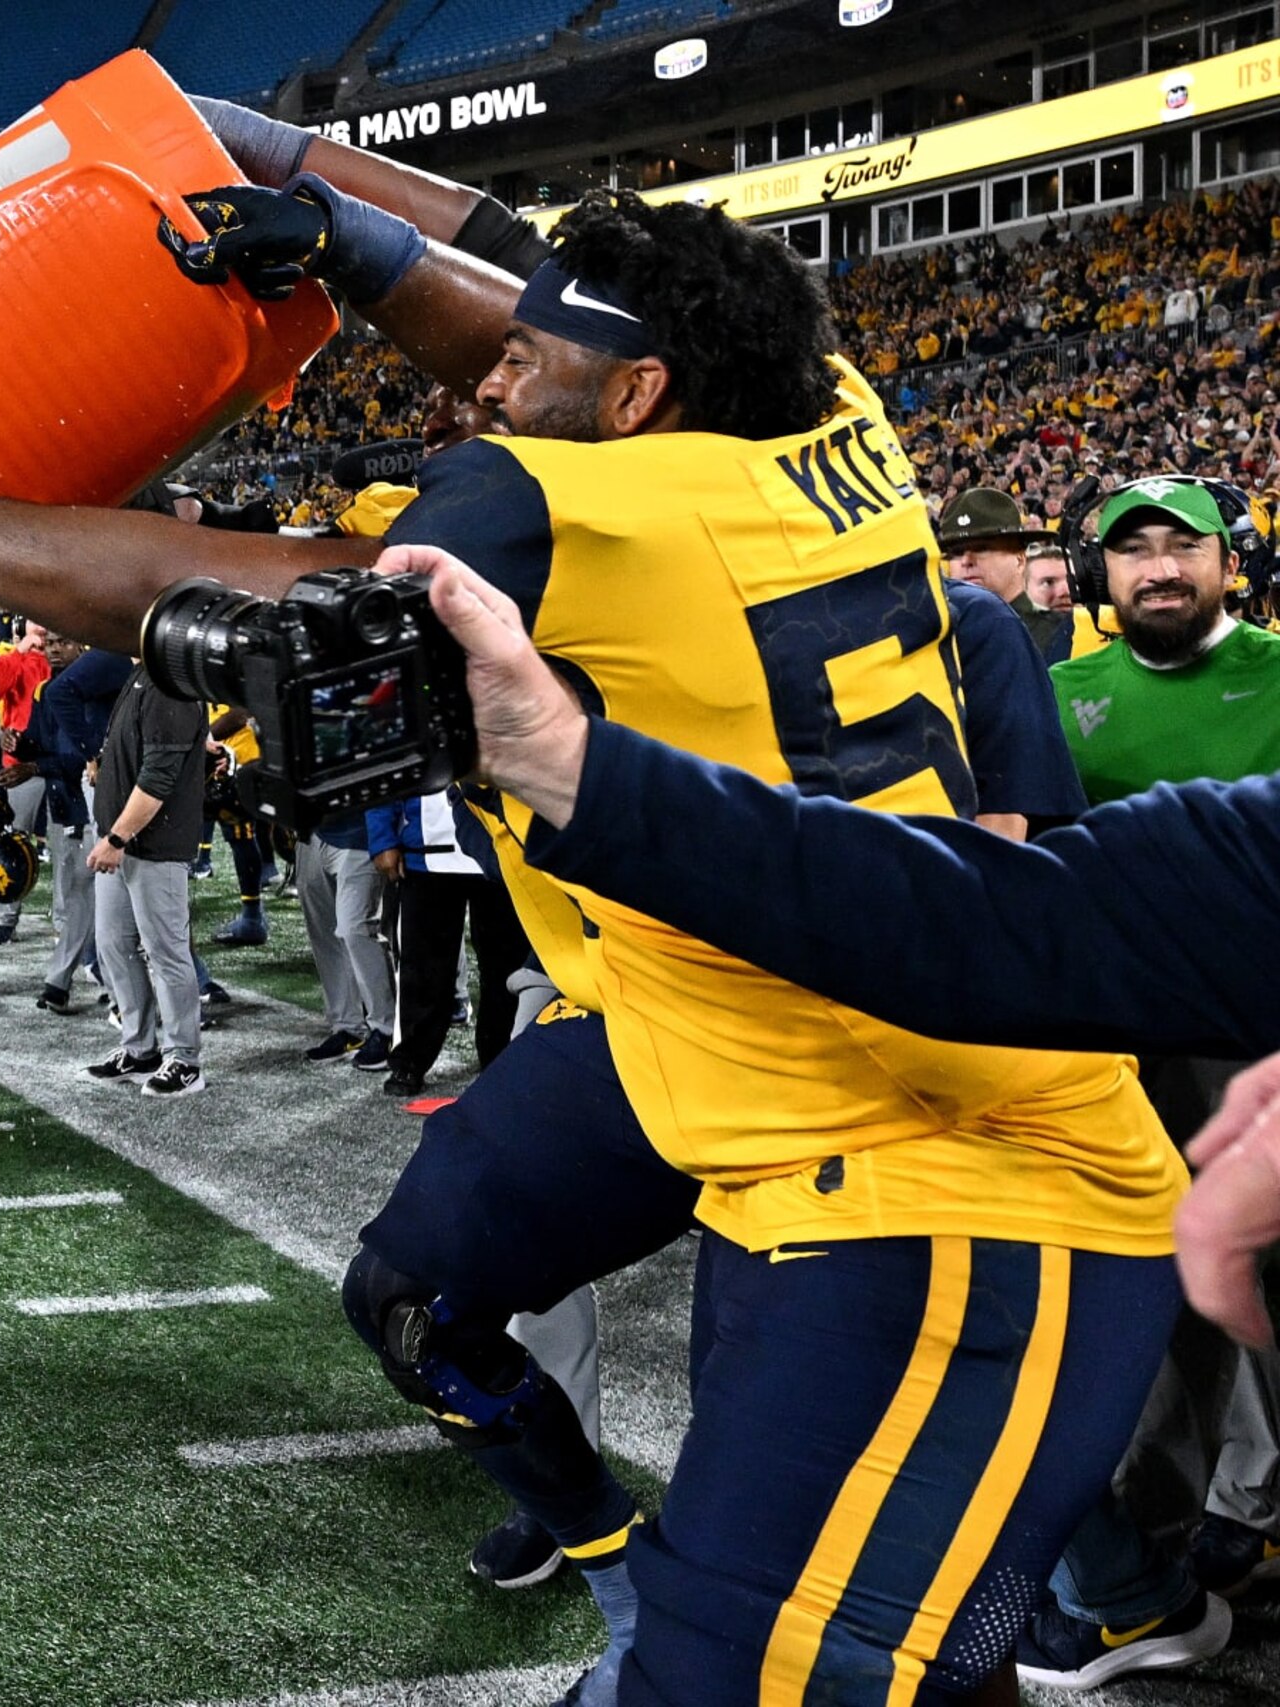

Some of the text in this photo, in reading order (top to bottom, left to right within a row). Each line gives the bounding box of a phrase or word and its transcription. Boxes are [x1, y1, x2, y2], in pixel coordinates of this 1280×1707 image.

[303, 81, 547, 148] 'S MAYO BOWL
[773, 175, 800, 198] GOT
[821, 135, 917, 203] Twang!
[776, 417, 915, 536] YATE
